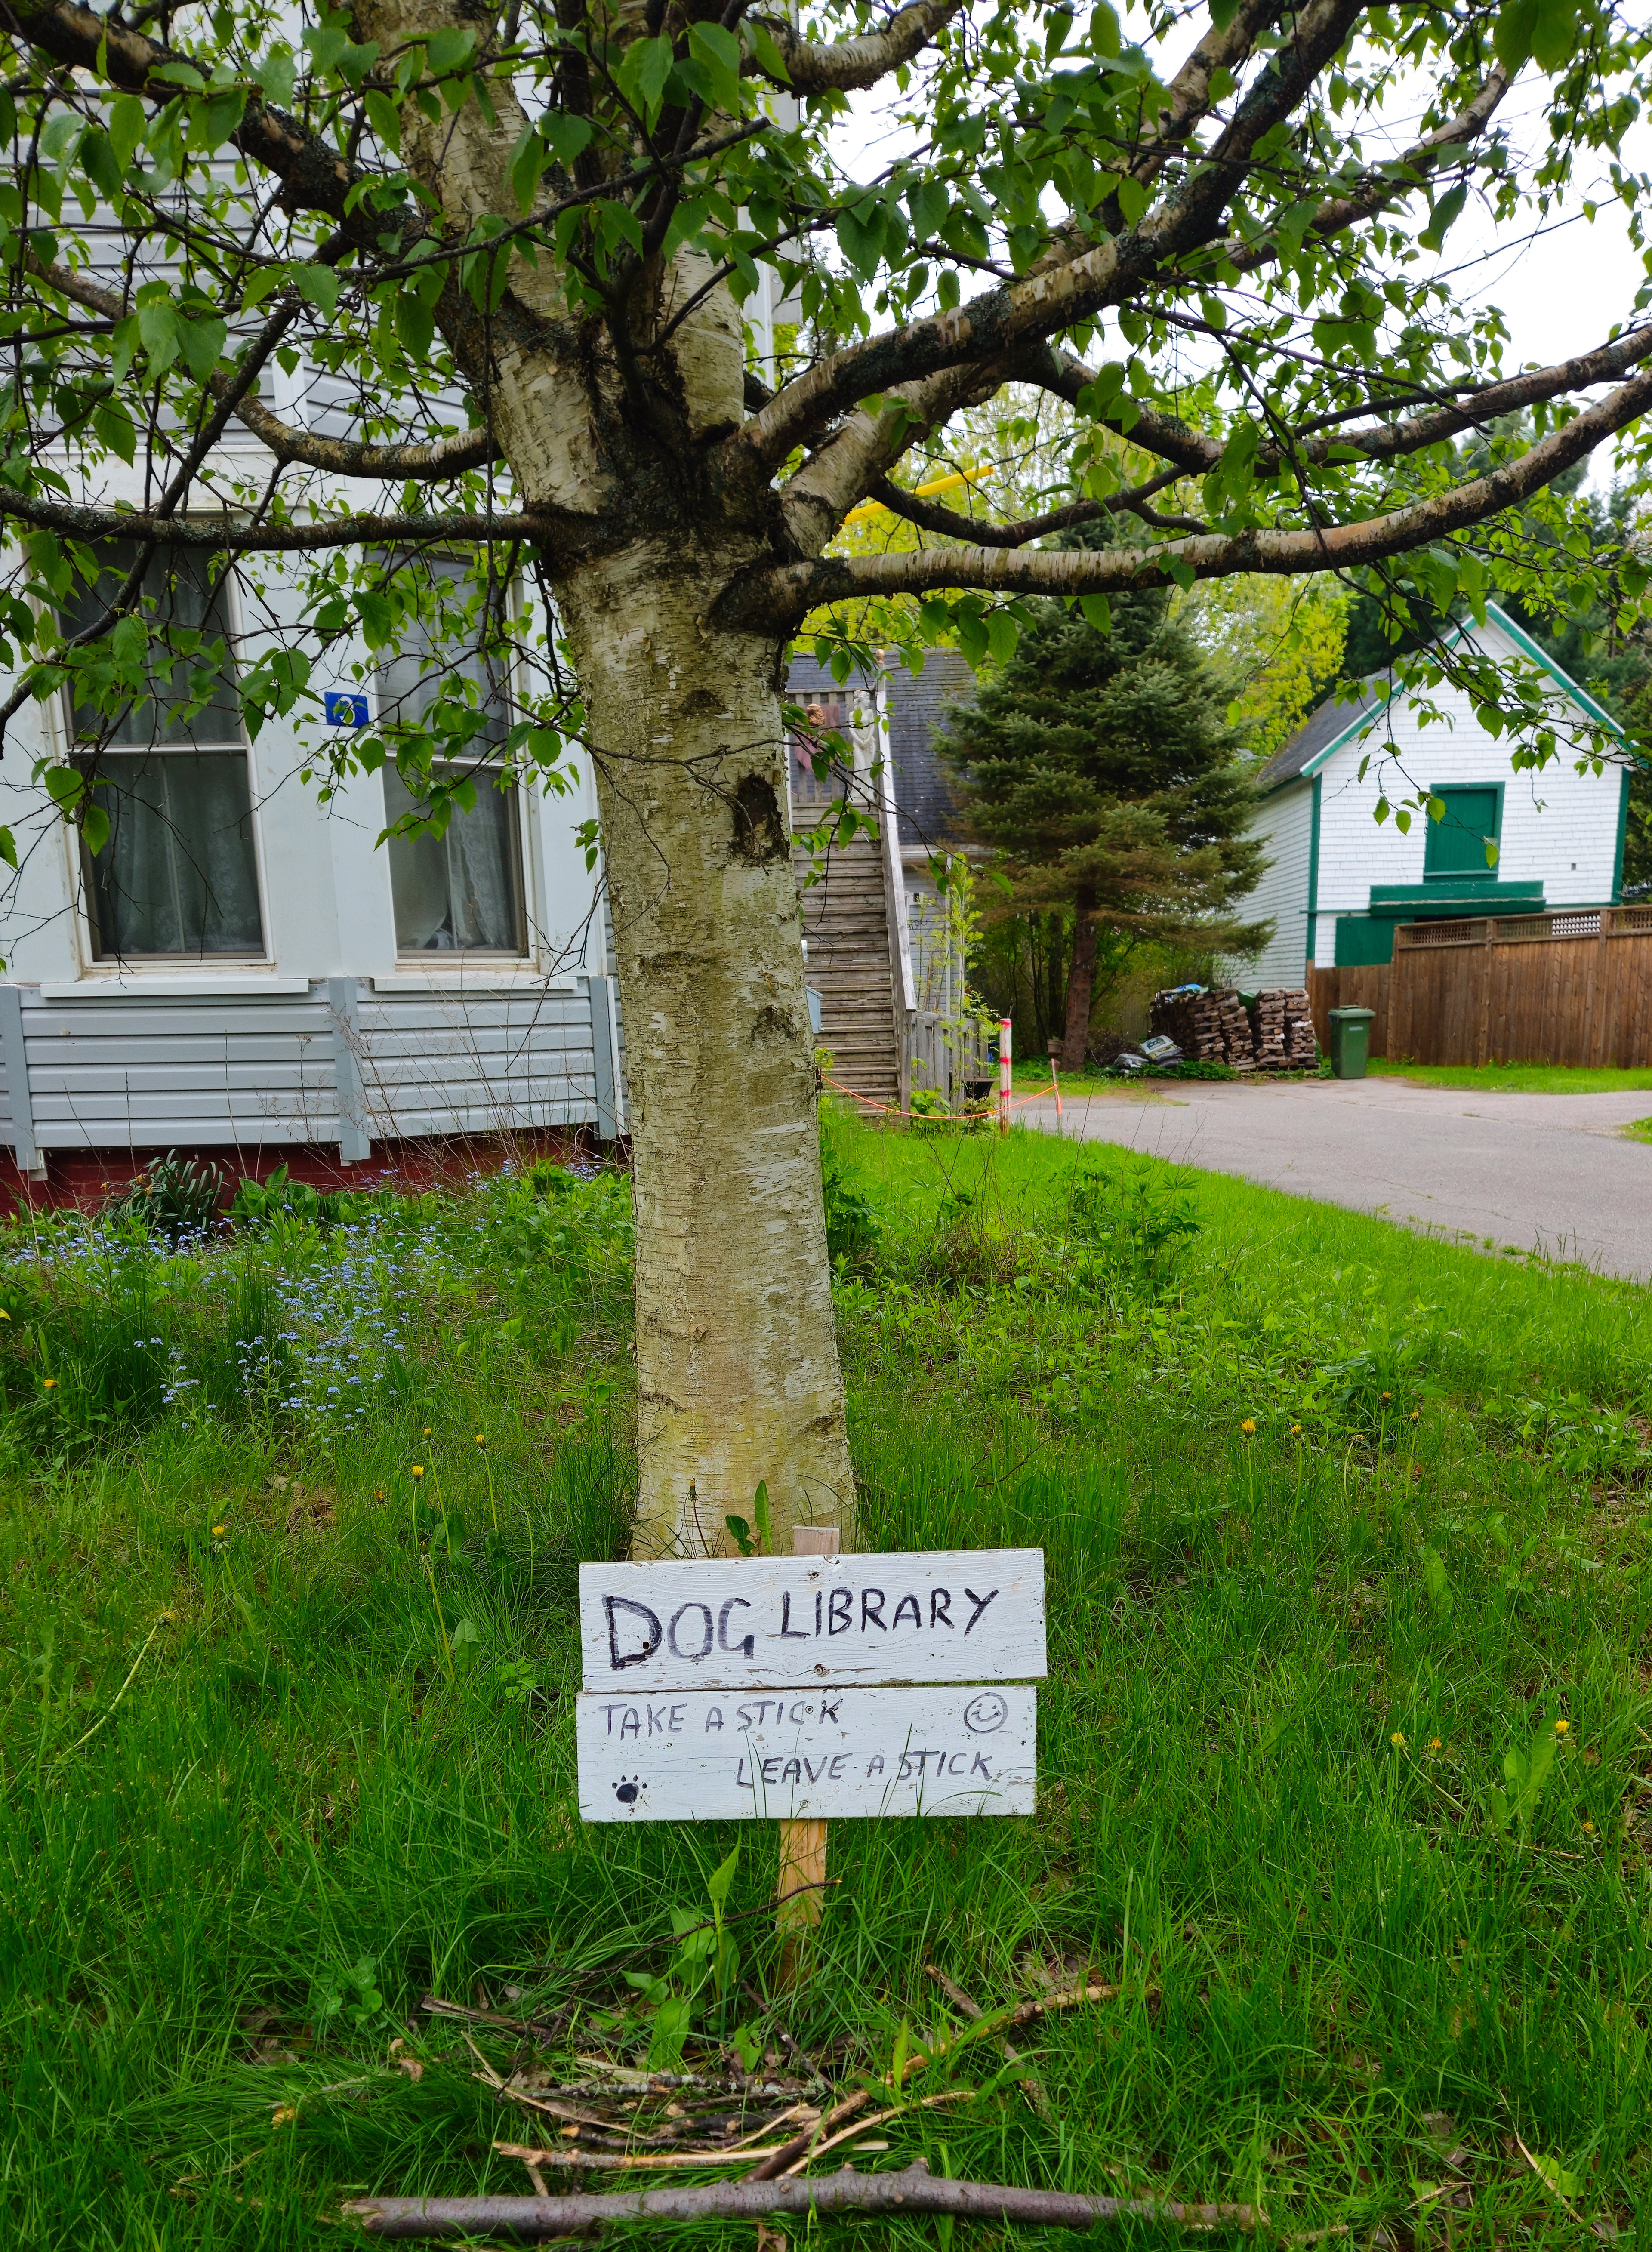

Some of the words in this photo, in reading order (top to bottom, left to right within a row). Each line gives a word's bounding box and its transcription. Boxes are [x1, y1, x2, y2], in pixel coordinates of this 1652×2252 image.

[602, 1594, 754, 1670] DOG
[780, 1587, 999, 1640] LIBRARY
[598, 1703, 687, 1740] TAKE
[705, 1707, 724, 1733] A
[737, 1698, 844, 1732] STICK
[736, 1752, 853, 1789] LEAVE
[867, 1755, 884, 1778] A
[898, 1751, 993, 1781] STICK
